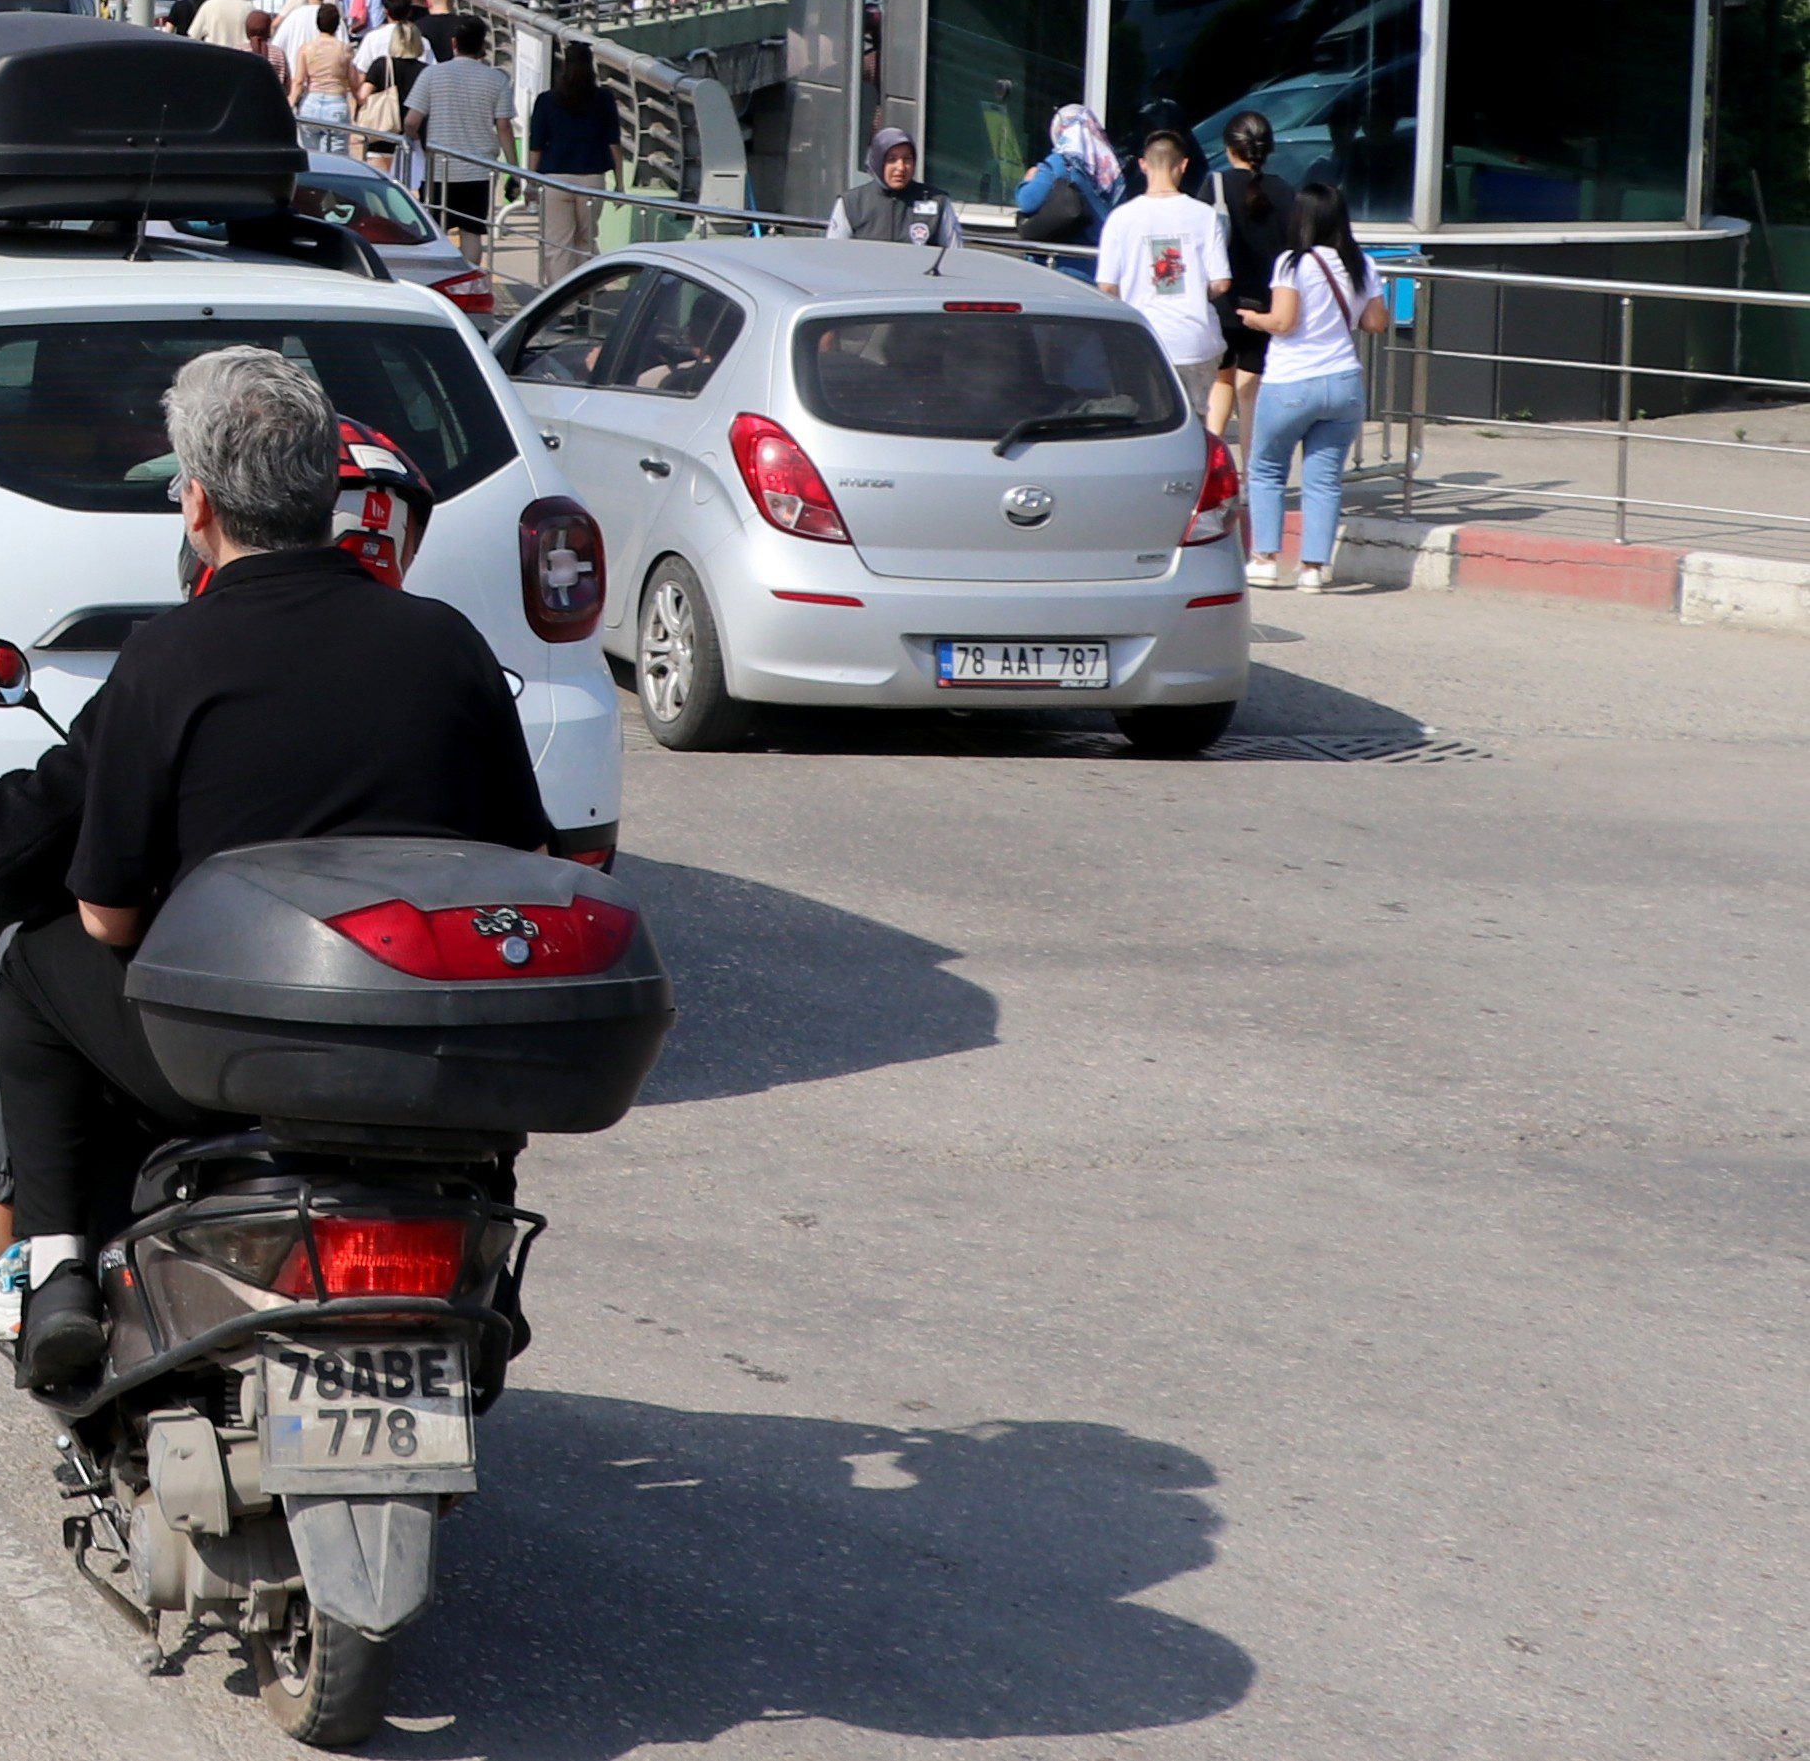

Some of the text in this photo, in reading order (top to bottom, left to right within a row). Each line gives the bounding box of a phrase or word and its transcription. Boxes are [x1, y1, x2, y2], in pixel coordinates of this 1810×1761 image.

[957, 646, 985, 675] 78
[1000, 646, 1045, 676] AAT
[1057, 647, 1101, 677] 787
[317, 1407, 418, 1458] 778
